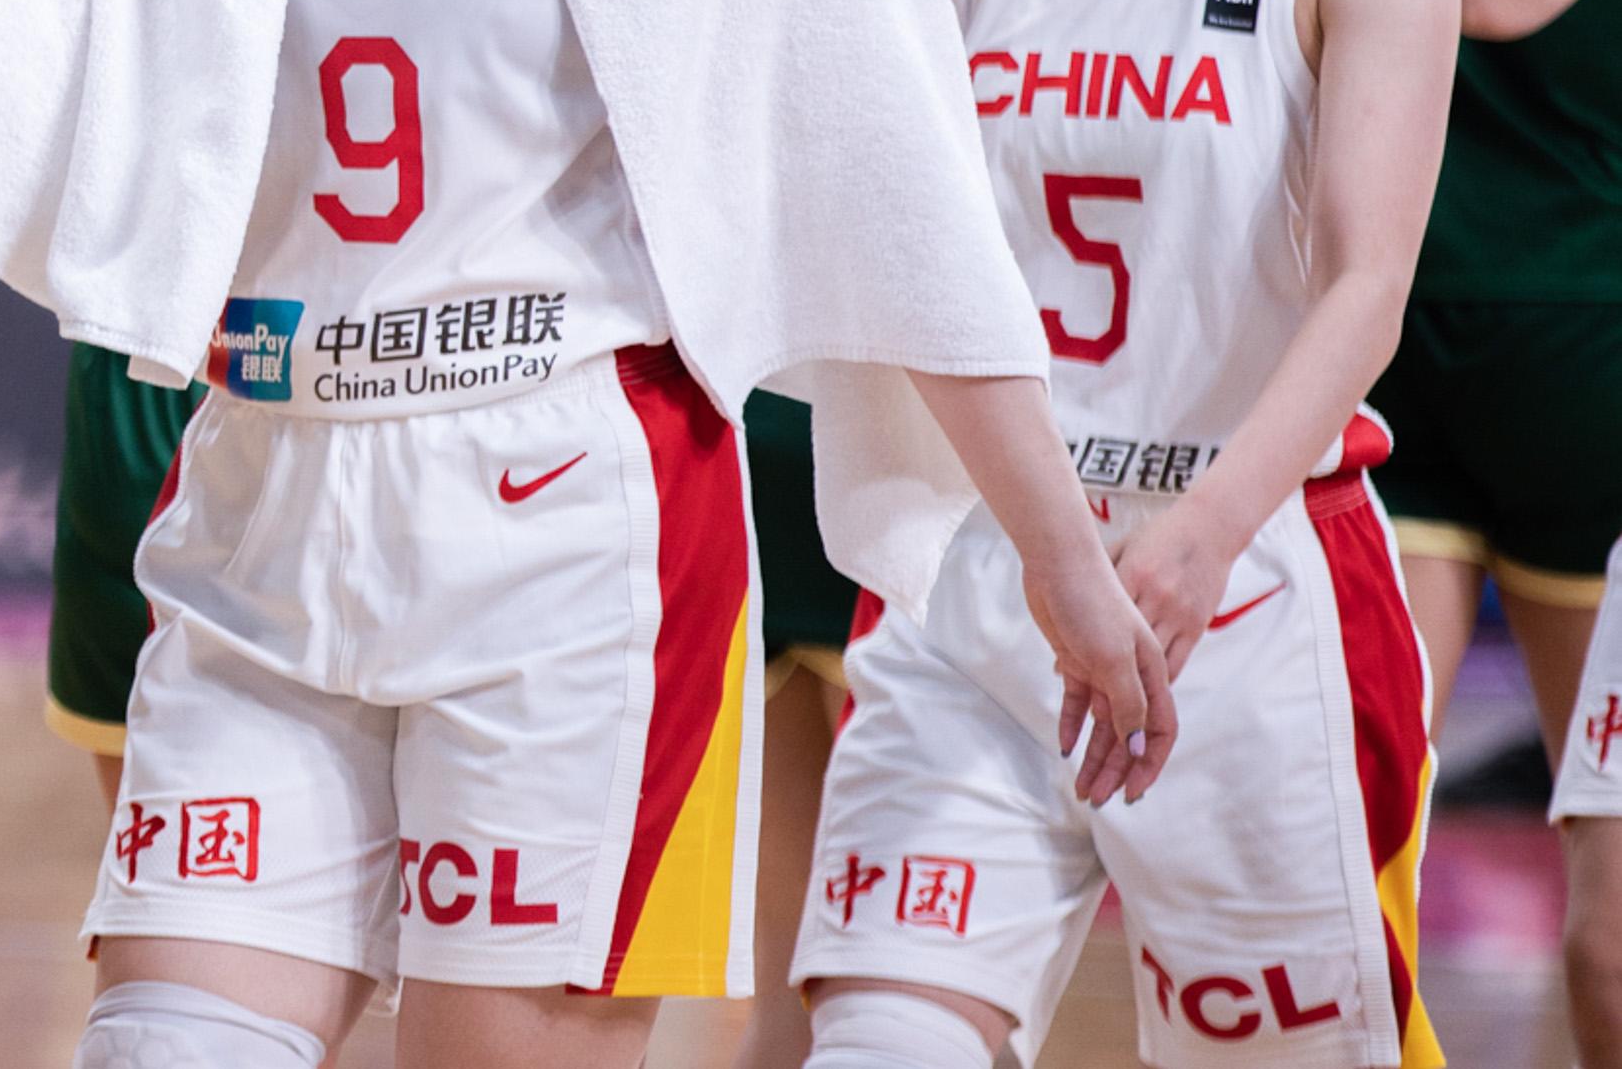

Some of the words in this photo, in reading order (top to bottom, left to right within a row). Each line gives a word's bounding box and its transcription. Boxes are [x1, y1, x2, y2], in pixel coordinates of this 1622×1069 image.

[969, 51, 1233, 127] CHINA
[313, 36, 425, 245] 9
[1039, 172, 1143, 366] 5
[315, 291, 567, 366] 中国银联
[314, 373, 396, 402] China
[405, 352, 559, 395] UnionPay
[1067, 437, 1221, 494] 国银
[116, 796, 261, 885] 中国
[825, 852, 976, 939] 中国
[1140, 944, 1341, 1043] TCL
